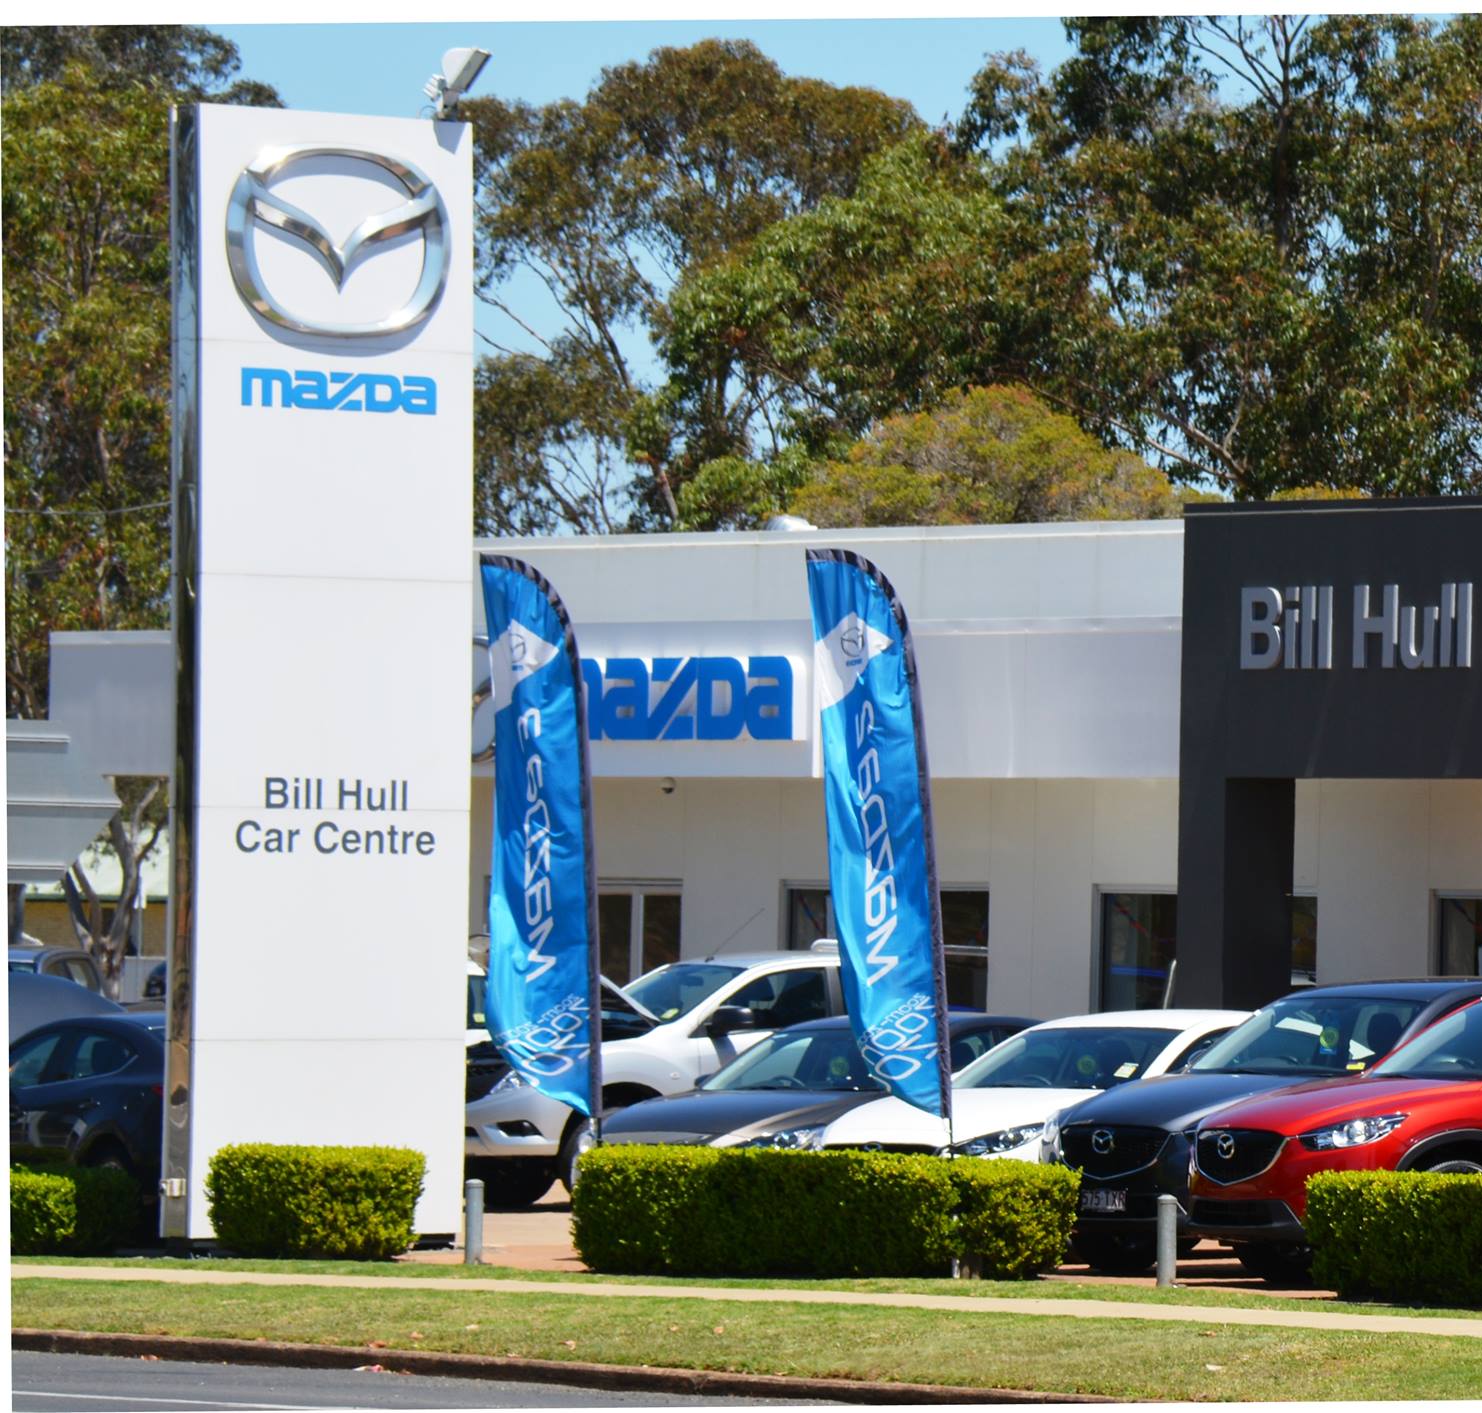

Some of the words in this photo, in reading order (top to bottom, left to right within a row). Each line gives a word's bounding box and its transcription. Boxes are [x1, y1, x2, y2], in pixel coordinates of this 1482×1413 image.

[241, 366, 438, 416] mazda
[1240, 584, 1334, 670] Bill
[1352, 582, 1473, 670] Hull
[582, 655, 794, 742] azda
[264, 777, 323, 810] Bill
[338, 779, 409, 812] Hull
[235, 820, 301, 854] Car
[313, 821, 436, 856] Centre
